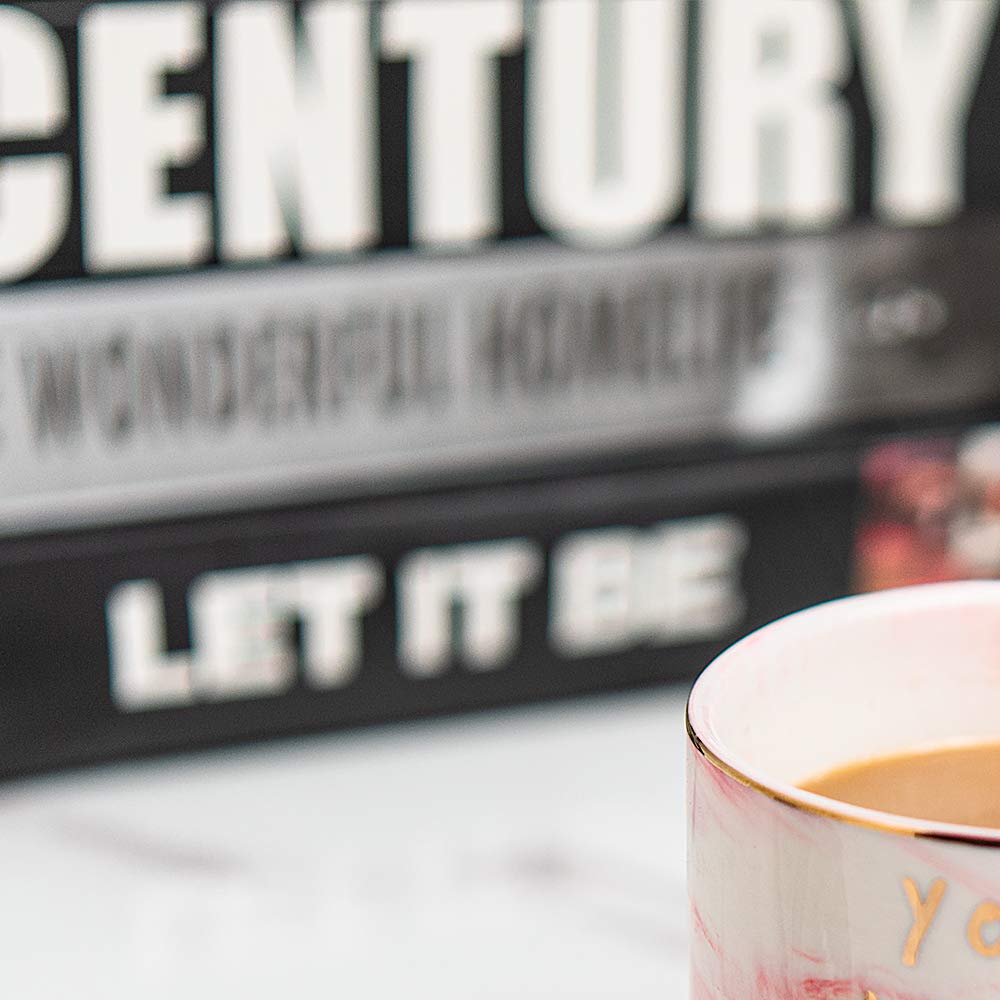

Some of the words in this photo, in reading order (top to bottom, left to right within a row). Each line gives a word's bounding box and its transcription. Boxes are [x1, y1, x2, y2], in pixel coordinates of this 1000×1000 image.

[106, 553, 385, 712] LET
[396, 536, 543, 678] IT
[548, 512, 750, 660] BE
